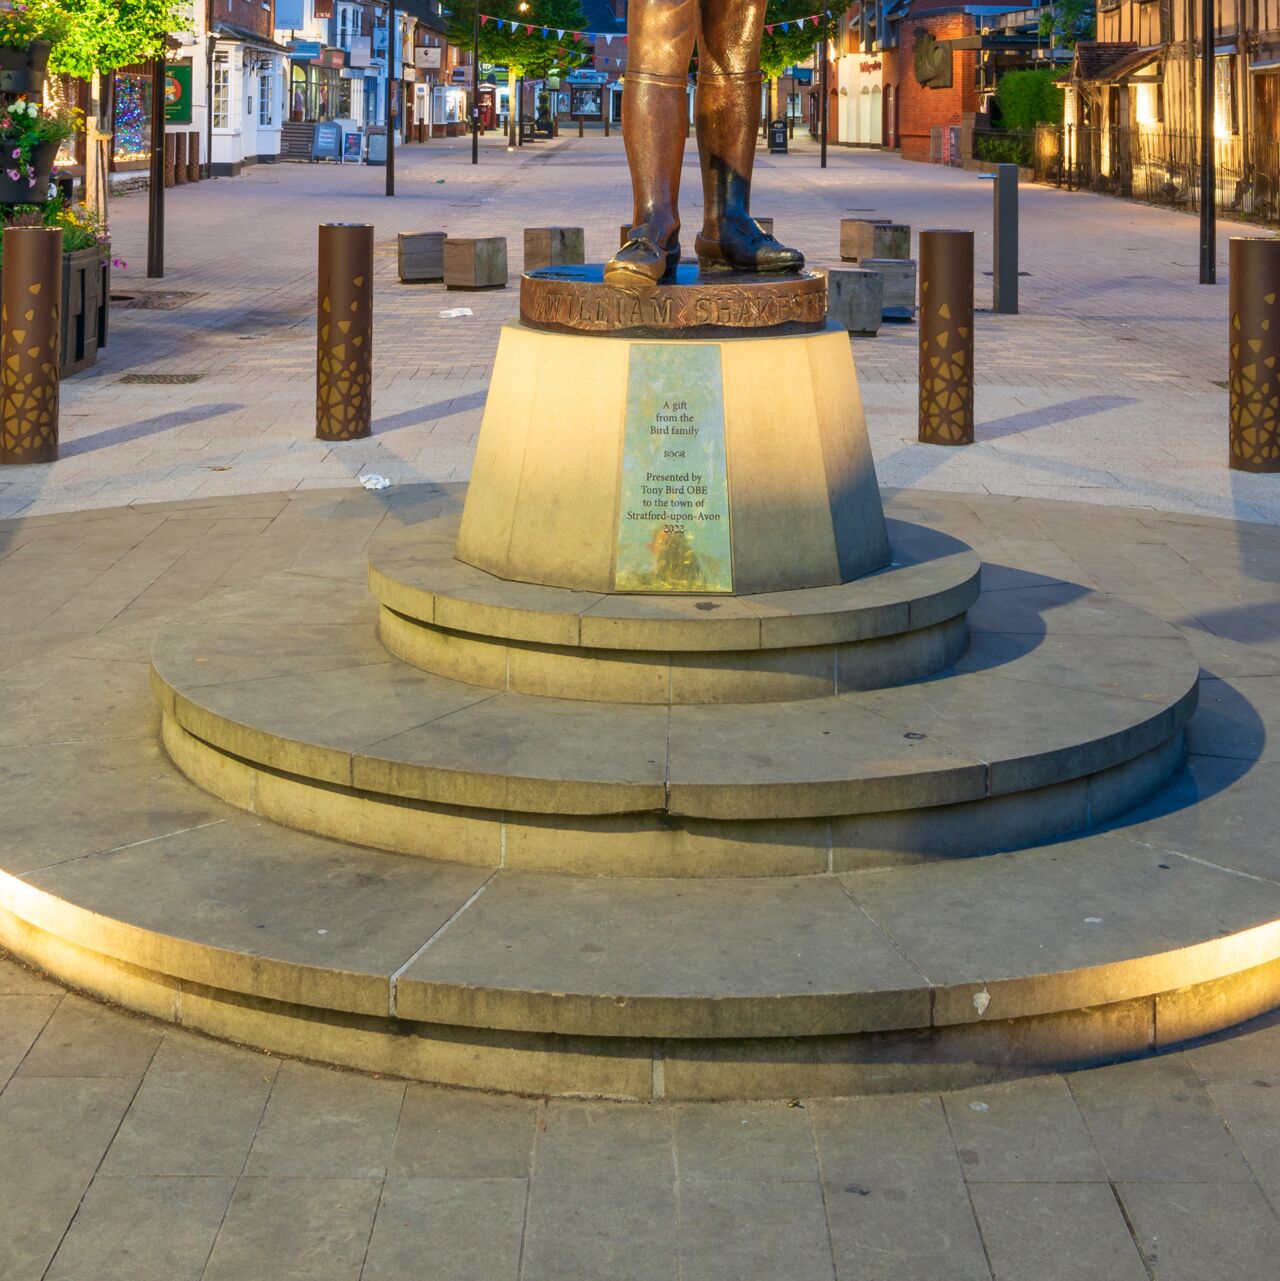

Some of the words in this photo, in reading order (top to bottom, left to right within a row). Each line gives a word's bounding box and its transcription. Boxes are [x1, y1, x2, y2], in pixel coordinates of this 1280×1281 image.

[546, 292, 673, 325] WILLIAM
[662, 401, 670, 409] A
[672, 401, 687, 412] gift
[656, 413, 677, 421] from
[680, 413, 694, 421] the
[650, 426, 669, 434] Bird
[671, 426, 699, 437] family
[646, 473, 689, 481] Presented
[691, 473, 703, 484] by
[641, 486, 663, 496] Tony
[665, 486, 684, 494] Bird
[687, 486, 708, 494] OBE
[643, 499, 652, 507] to
[654, 498, 668, 507] the
[671, 499, 693, 507] town
[695, 498, 705, 507] of
[627, 511, 721, 522] Stratford-upon-Avon
[663, 525, 685, 533] 2022
